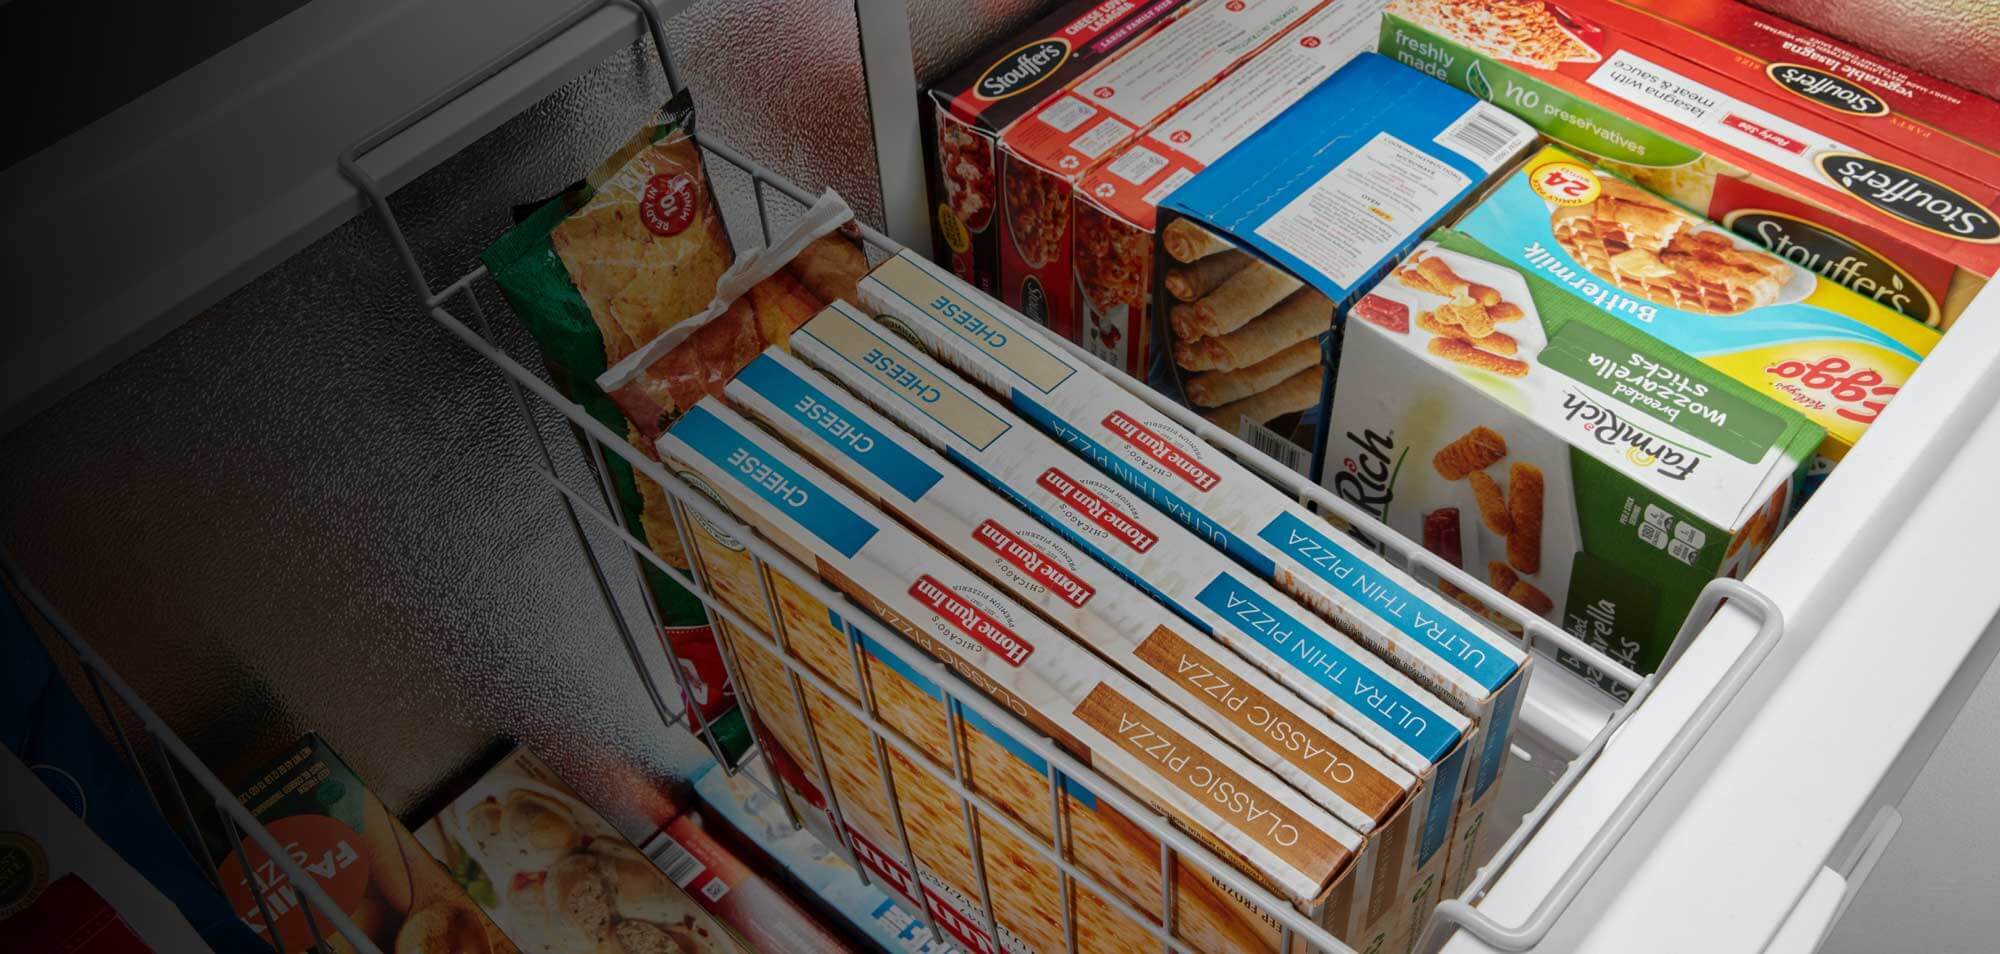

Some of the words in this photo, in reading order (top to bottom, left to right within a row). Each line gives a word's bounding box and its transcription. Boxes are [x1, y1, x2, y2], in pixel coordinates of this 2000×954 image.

[983, 44, 1061, 96] Stouffer's
[1395, 30, 1455, 68] freshly
[1397, 49, 1448, 82] made
[1782, 41, 1842, 71] lasagna
[1610, 70, 1642, 91] with
[1613, 60, 1660, 84] sauce
[1660, 79, 1674, 89] &
[1781, 68, 1876, 112] Stouffer's
[1842, 64, 1914, 98] vegetable
[1504, 80, 1540, 110] no
[1544, 104, 1646, 157] preservatives
[1644, 85, 1705, 119] lasagna
[1673, 86, 1716, 109] meat
[1544, 171, 1590, 197] 24
[1838, 160, 1988, 235] Stouffer's
[660, 194, 679, 217] 10
[1524, 240, 1659, 324] Buttermilk
[930, 295, 1008, 349] CHEESE
[863, 348, 941, 403] CHEESE
[1587, 351, 1728, 429] mozzarella
[1627, 352, 1710, 399] sticks
[1767, 356, 1902, 426] Eggo
[1774, 381, 1827, 412] Kellogg's
[1611, 380, 1681, 423] breaded
[795, 395, 875, 454] CHEESE
[1110, 413, 1140, 438] Inn
[1136, 430, 1171, 460] Run
[727, 447, 809, 508] CHEESE
[1124, 443, 1173, 478] CHICAGO'S
[1167, 451, 1217, 490] Home
[1046, 470, 1076, 497] Inn
[1072, 488, 1107, 519] Run
[981, 523, 1011, 551] Inn
[1059, 503, 1109, 540] CHICAGO'S
[1103, 510, 1154, 551] Home
[1008, 542, 1044, 573] Run
[1288, 527, 1351, 579] PIZZA
[917, 578, 948, 608] Inn
[995, 558, 1046, 594] CHICAGO'S
[1039, 563, 1091, 605] Home
[1351, 574, 1408, 617] THIN
[871, 600, 933, 651] PIZZA
[932, 615, 982, 653] CHICAGO'S
[944, 598, 981, 631] Run
[1226, 591, 1293, 645] PIZZA
[977, 620, 1030, 664] Home
[1413, 611, 1488, 670] ULTRA
[938, 647, 1028, 718] CLASSIC
[1176, 653, 1249, 713] PIZZA
[1290, 638, 1349, 686] THIN
[1352, 676, 1428, 738] ULTRA
[1118, 712, 1191, 773] PIZZA
[1246, 705, 1355, 784] CLASSIC
[1188, 765, 1300, 847] CLASSIC
